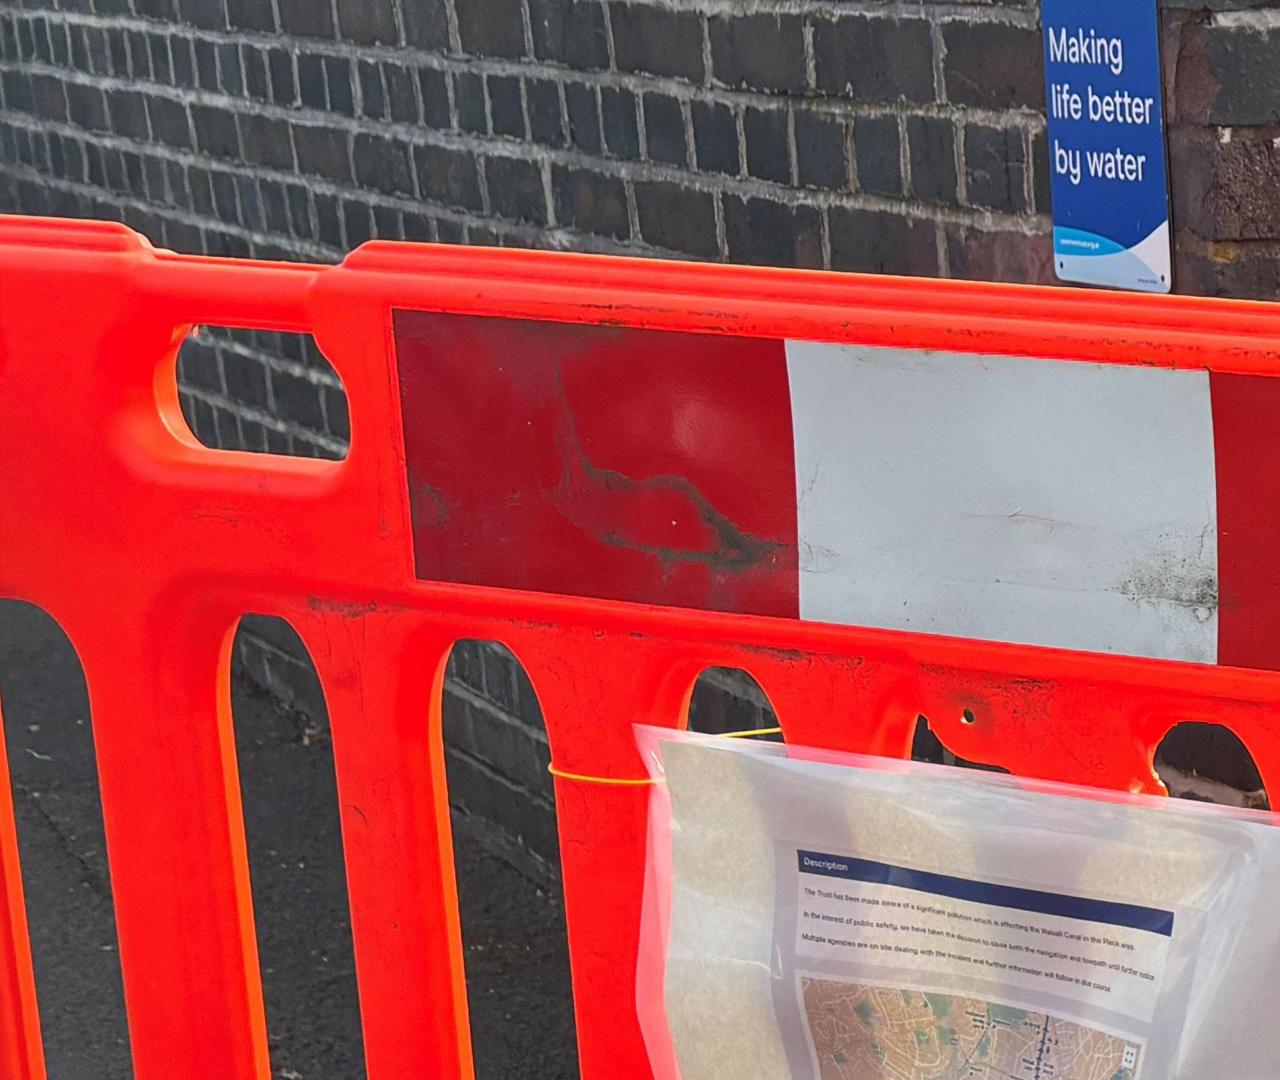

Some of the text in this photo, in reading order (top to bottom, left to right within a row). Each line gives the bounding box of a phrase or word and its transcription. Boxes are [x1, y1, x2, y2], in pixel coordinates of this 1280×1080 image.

[1048, 27, 1123, 75] Making
[1051, 84, 1153, 125] life better
[1054, 140, 1146, 185] by water
[803, 857, 848, 872] Description
